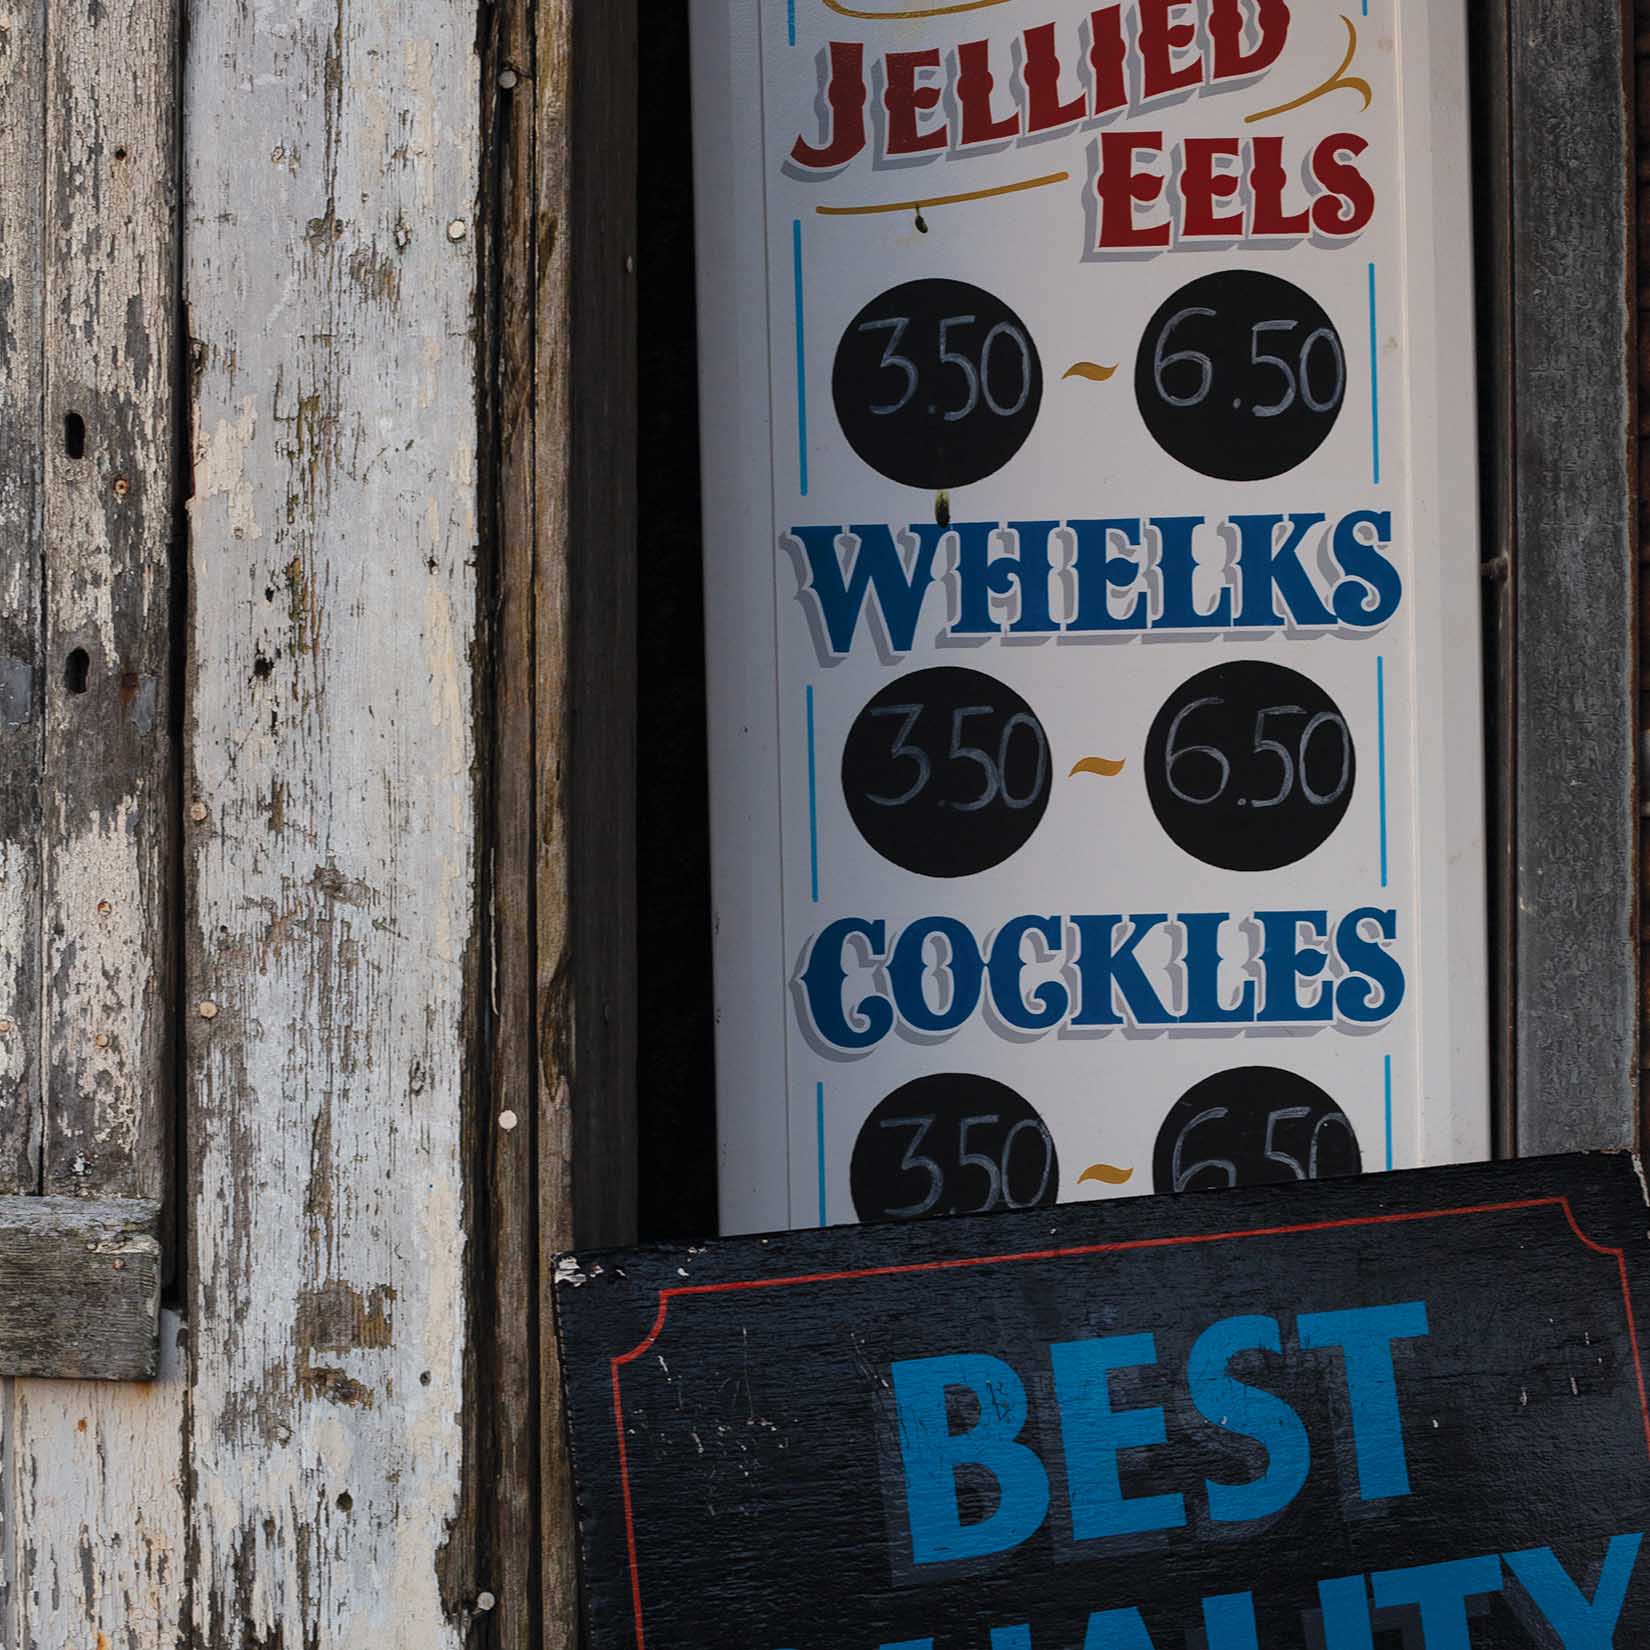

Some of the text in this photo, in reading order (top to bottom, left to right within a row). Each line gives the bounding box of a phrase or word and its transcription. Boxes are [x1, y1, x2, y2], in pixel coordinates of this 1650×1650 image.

[790, 0, 1291, 168] JELLIED
[1098, 131, 1375, 248] EELS
[858, 307, 1345, 421] 3.50 6.50
[790, 510, 1402, 652] WHELKS
[864, 697, 1349, 811] 3.50 6.50
[800, 906, 1405, 1049] COCKLES
[890, 1301, 1429, 1565] BEST
